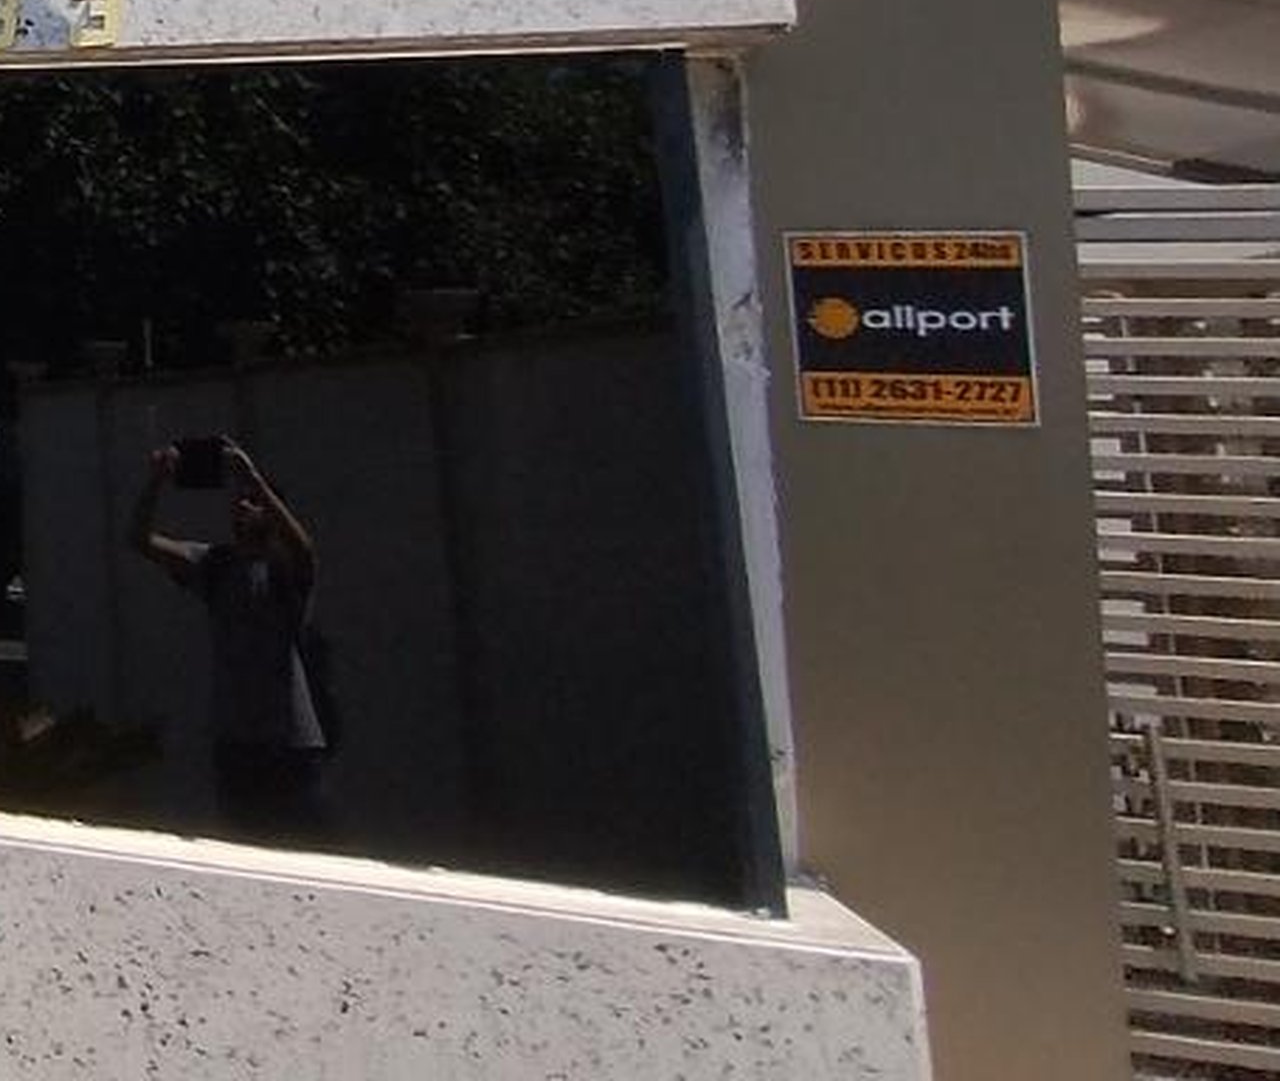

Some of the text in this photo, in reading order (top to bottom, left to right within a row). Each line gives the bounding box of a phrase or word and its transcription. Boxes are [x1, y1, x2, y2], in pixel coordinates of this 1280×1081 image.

[862, 305, 1015, 336] allport
[811, 378, 1022, 403] (11) 2631-2727
